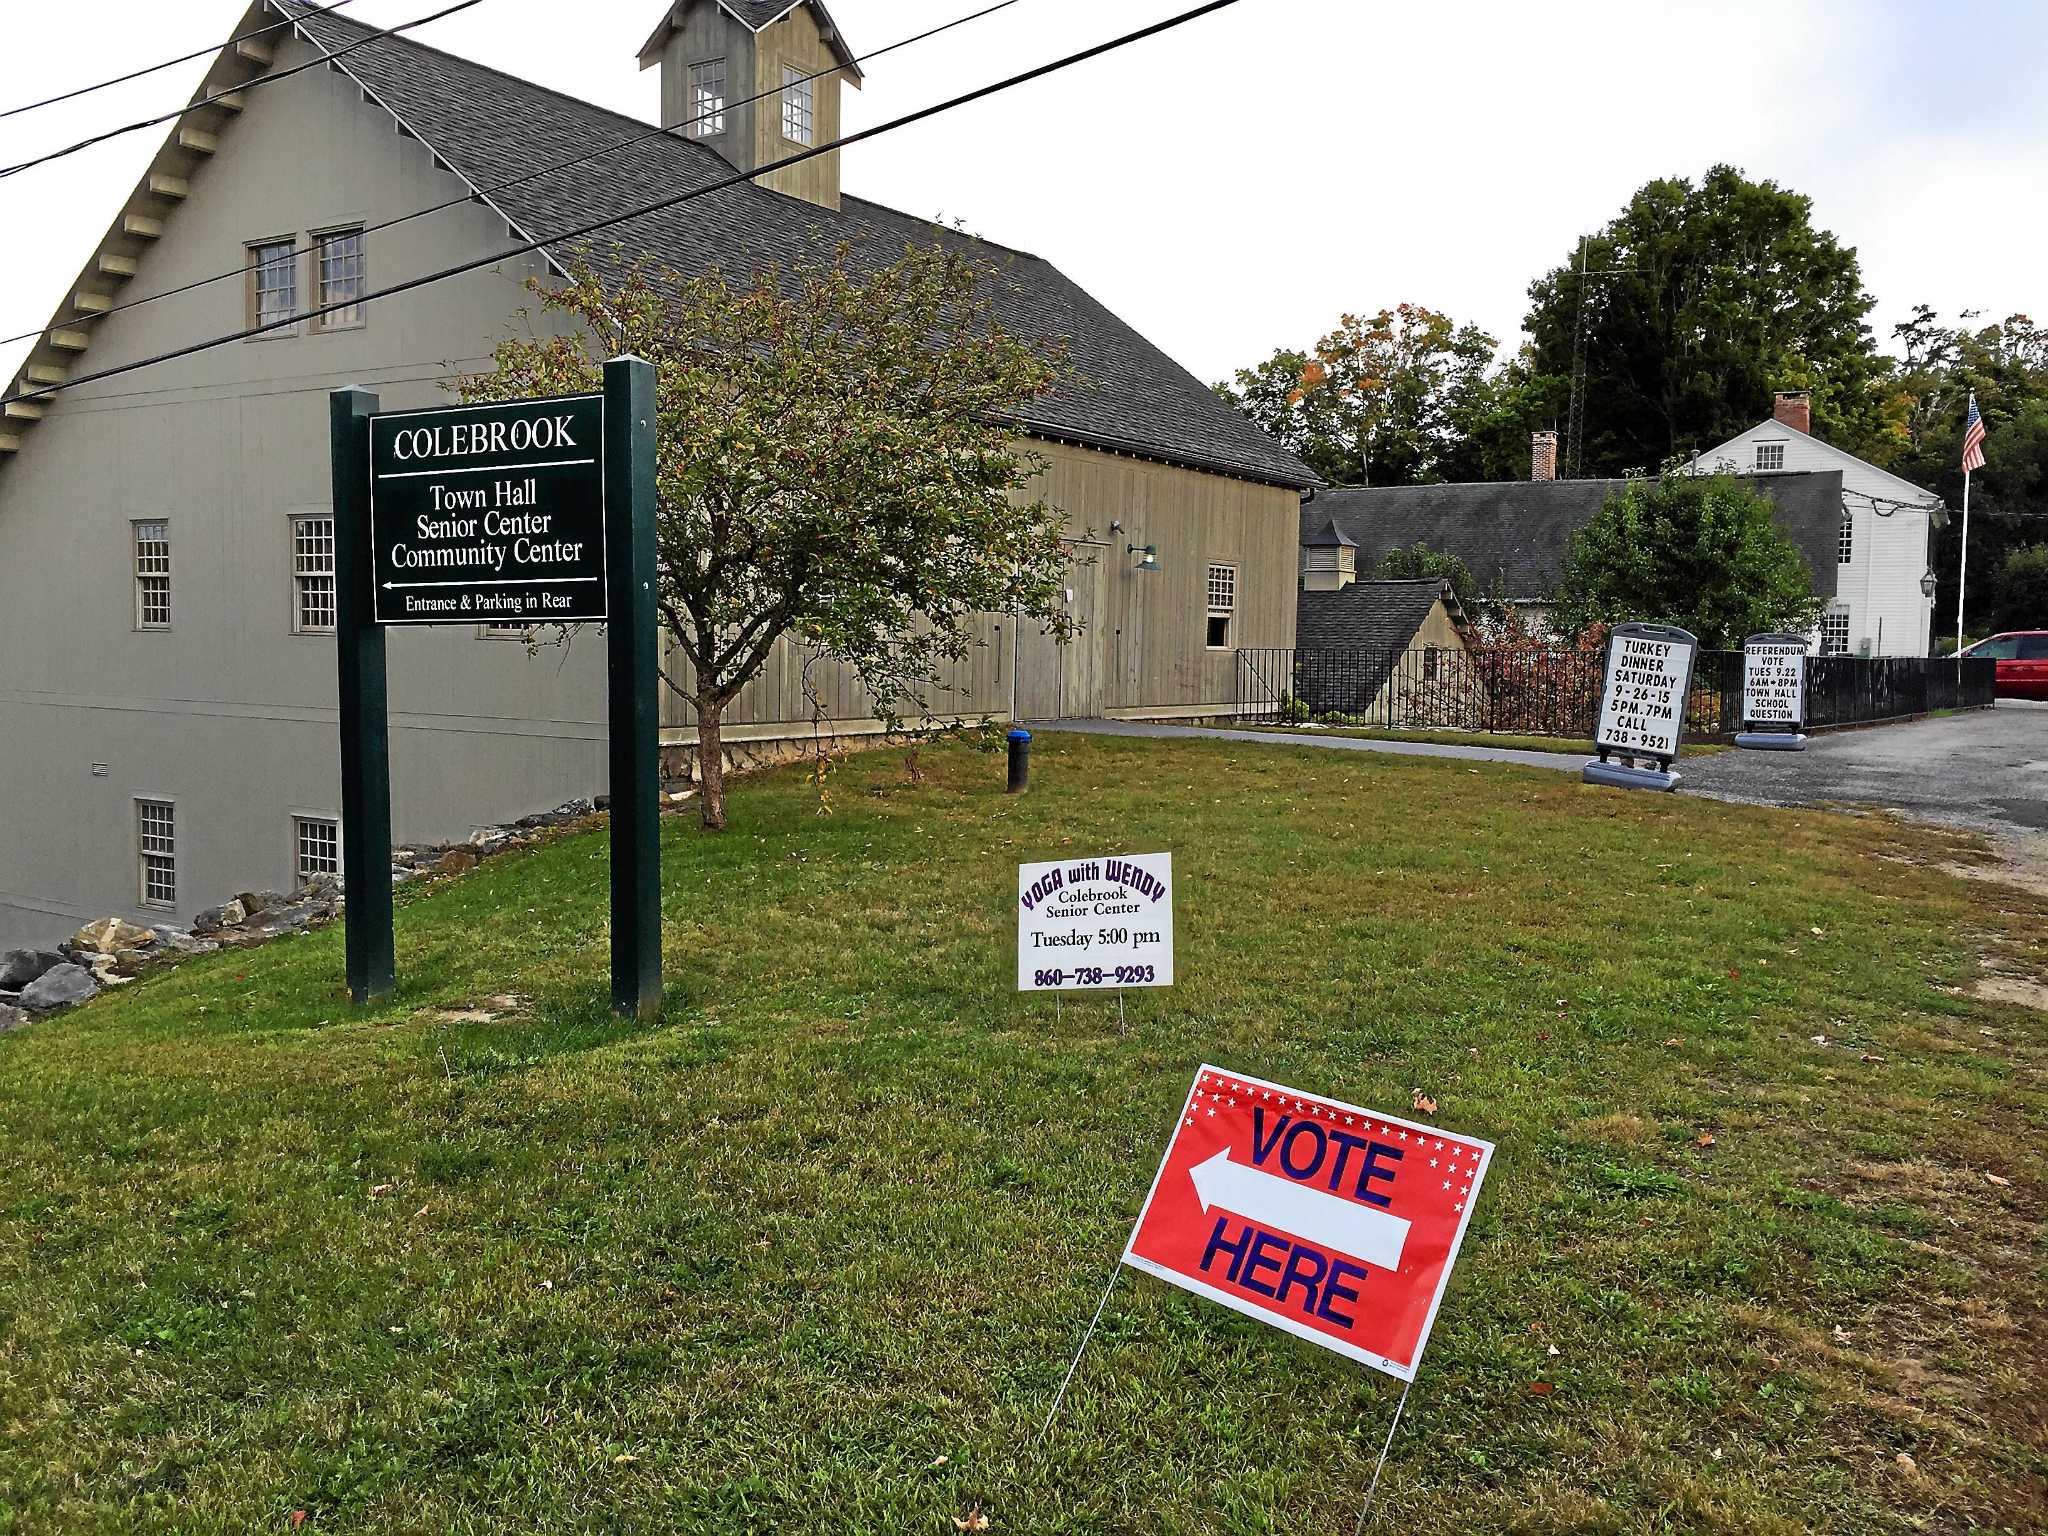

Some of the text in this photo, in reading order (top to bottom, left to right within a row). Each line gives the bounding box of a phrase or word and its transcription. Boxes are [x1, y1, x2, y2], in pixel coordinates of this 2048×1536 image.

[394, 415, 577, 459] COLEBROOK
[430, 479, 536, 510] Town Hall
[417, 511, 551, 539] Senior Center
[392, 538, 582, 571] Community Center
[406, 593, 572, 612] Entrance & Parking in Rear
[1625, 640, 1671, 657] TURKEY
[1746, 647, 1804, 655] REFERENDUM
[1621, 656, 1663, 672] DINNER
[1762, 657, 1784, 665] VOTE
[1615, 670, 1676, 688] SATURDAY
[1749, 668, 1796, 676] TUES 9.22
[1778, 679, 1797, 687] 8PM
[1746, 689, 1796, 698] TOWN HALL
[1756, 699, 1788, 708] SCHOOL
[1750, 710, 1792, 718] QUESTION
[1618, 716, 1646, 731] CALL
[1022, 860, 1166, 910] YOGA with WENDY
[1058, 886, 1127, 903] Colebrook
[1046, 903, 1140, 918] Senior Center
[1031, 928, 1160, 950] Tuesday 5:00 pm
[1252, 1107, 1404, 1208] VOTE
[1200, 1217, 1369, 1329] HERE
